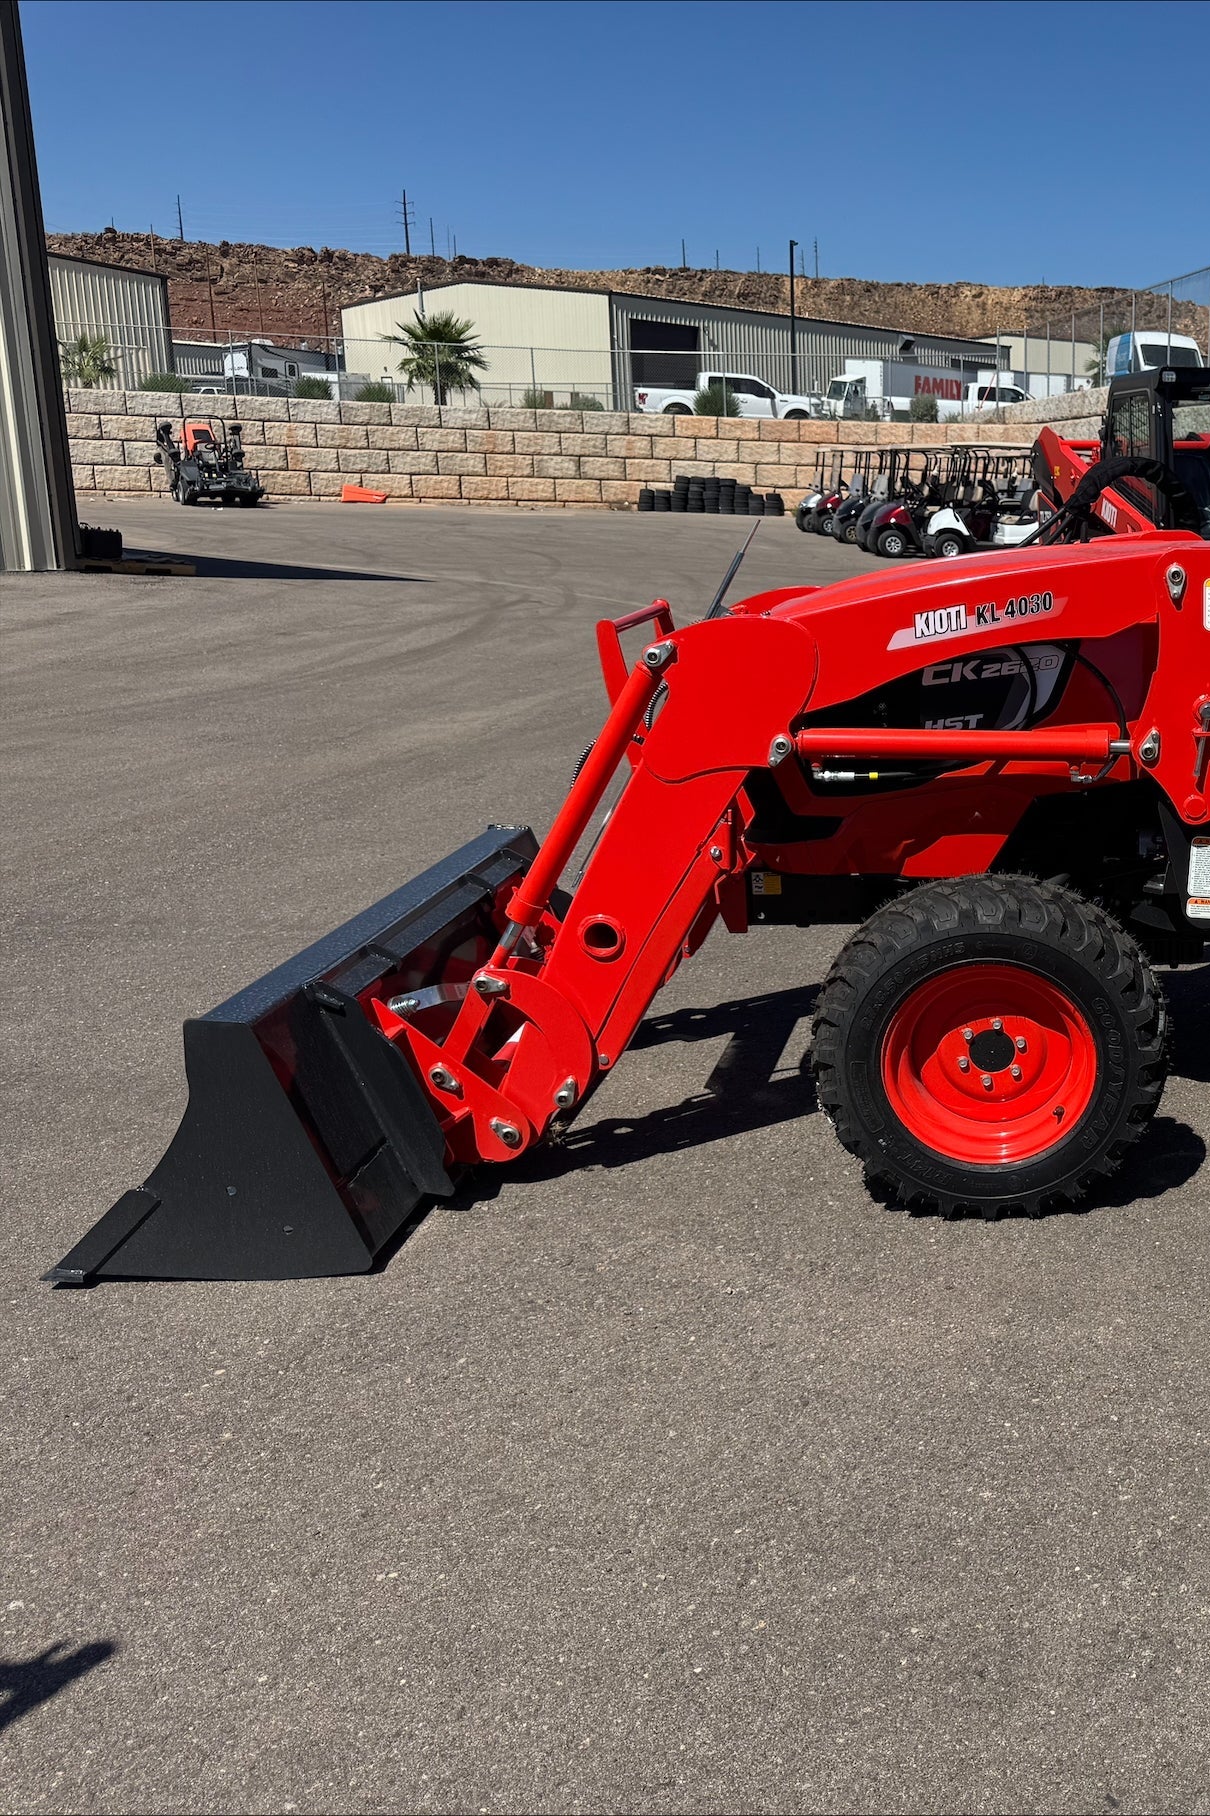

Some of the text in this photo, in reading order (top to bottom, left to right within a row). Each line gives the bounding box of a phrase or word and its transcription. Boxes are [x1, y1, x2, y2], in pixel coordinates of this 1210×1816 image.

[914, 375, 962, 400] FAMILY
[913, 591, 1054, 639] KIOTI KL 4030
[924, 714, 984, 730] HST
